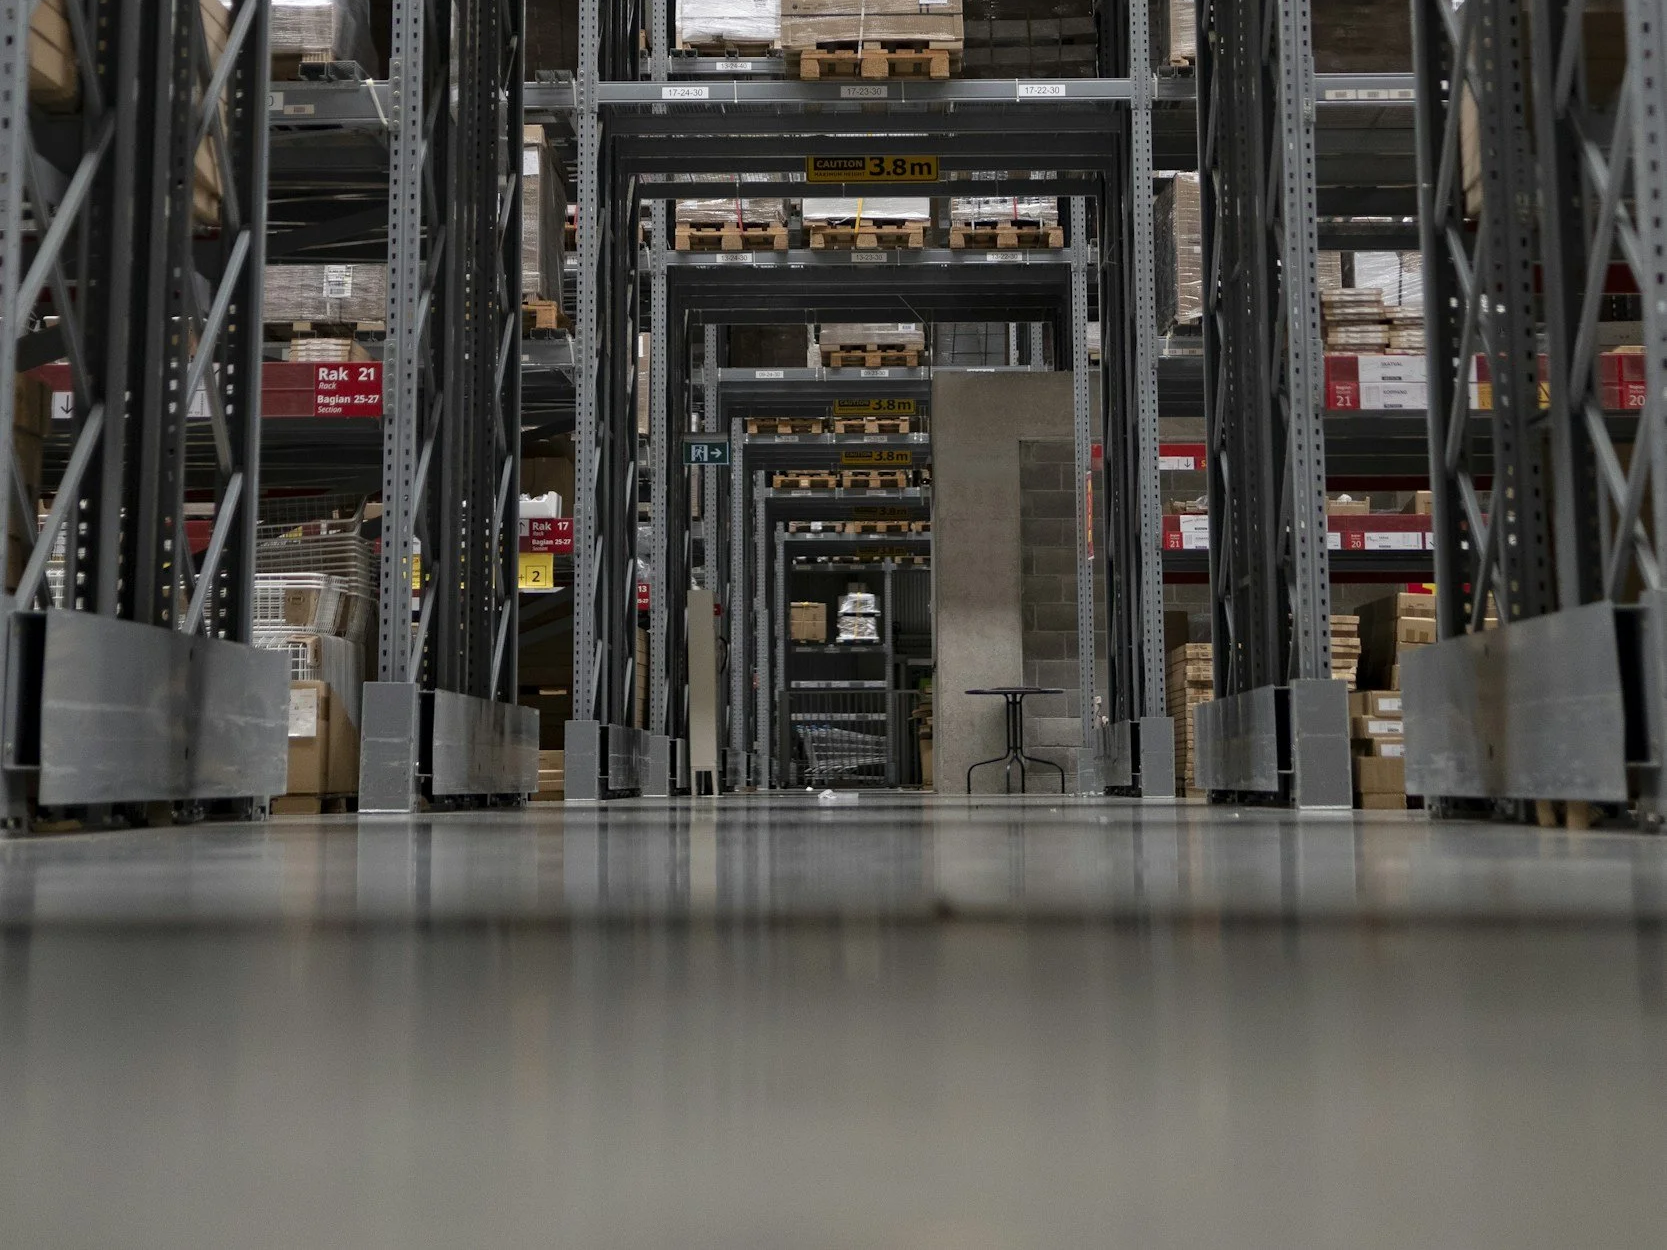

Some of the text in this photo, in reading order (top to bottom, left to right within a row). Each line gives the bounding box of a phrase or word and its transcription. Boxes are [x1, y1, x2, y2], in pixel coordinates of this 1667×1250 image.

[668, 88, 703, 97] 17-24-30
[846, 87, 882, 96] 17-23-30
[1025, 86, 1060, 95] 17-22-30
[816, 159, 863, 168] CAUTION
[318, 366, 375, 381] Rak 21
[318, 381, 337, 390] Rack
[317, 395, 379, 405] Bagian 25-27
[1336, 395, 1352, 407] 21
[1628, 395, 1646, 406] 20
[317, 405, 342, 414] Section
[532, 521, 569, 531] Rak 17
[532, 538, 554, 546] Bagian
[1169, 540, 1181, 548] 21
[1351, 540, 1362, 548] 20
[531, 570, 540, 583] 2
[638, 585, 647, 593] 13
